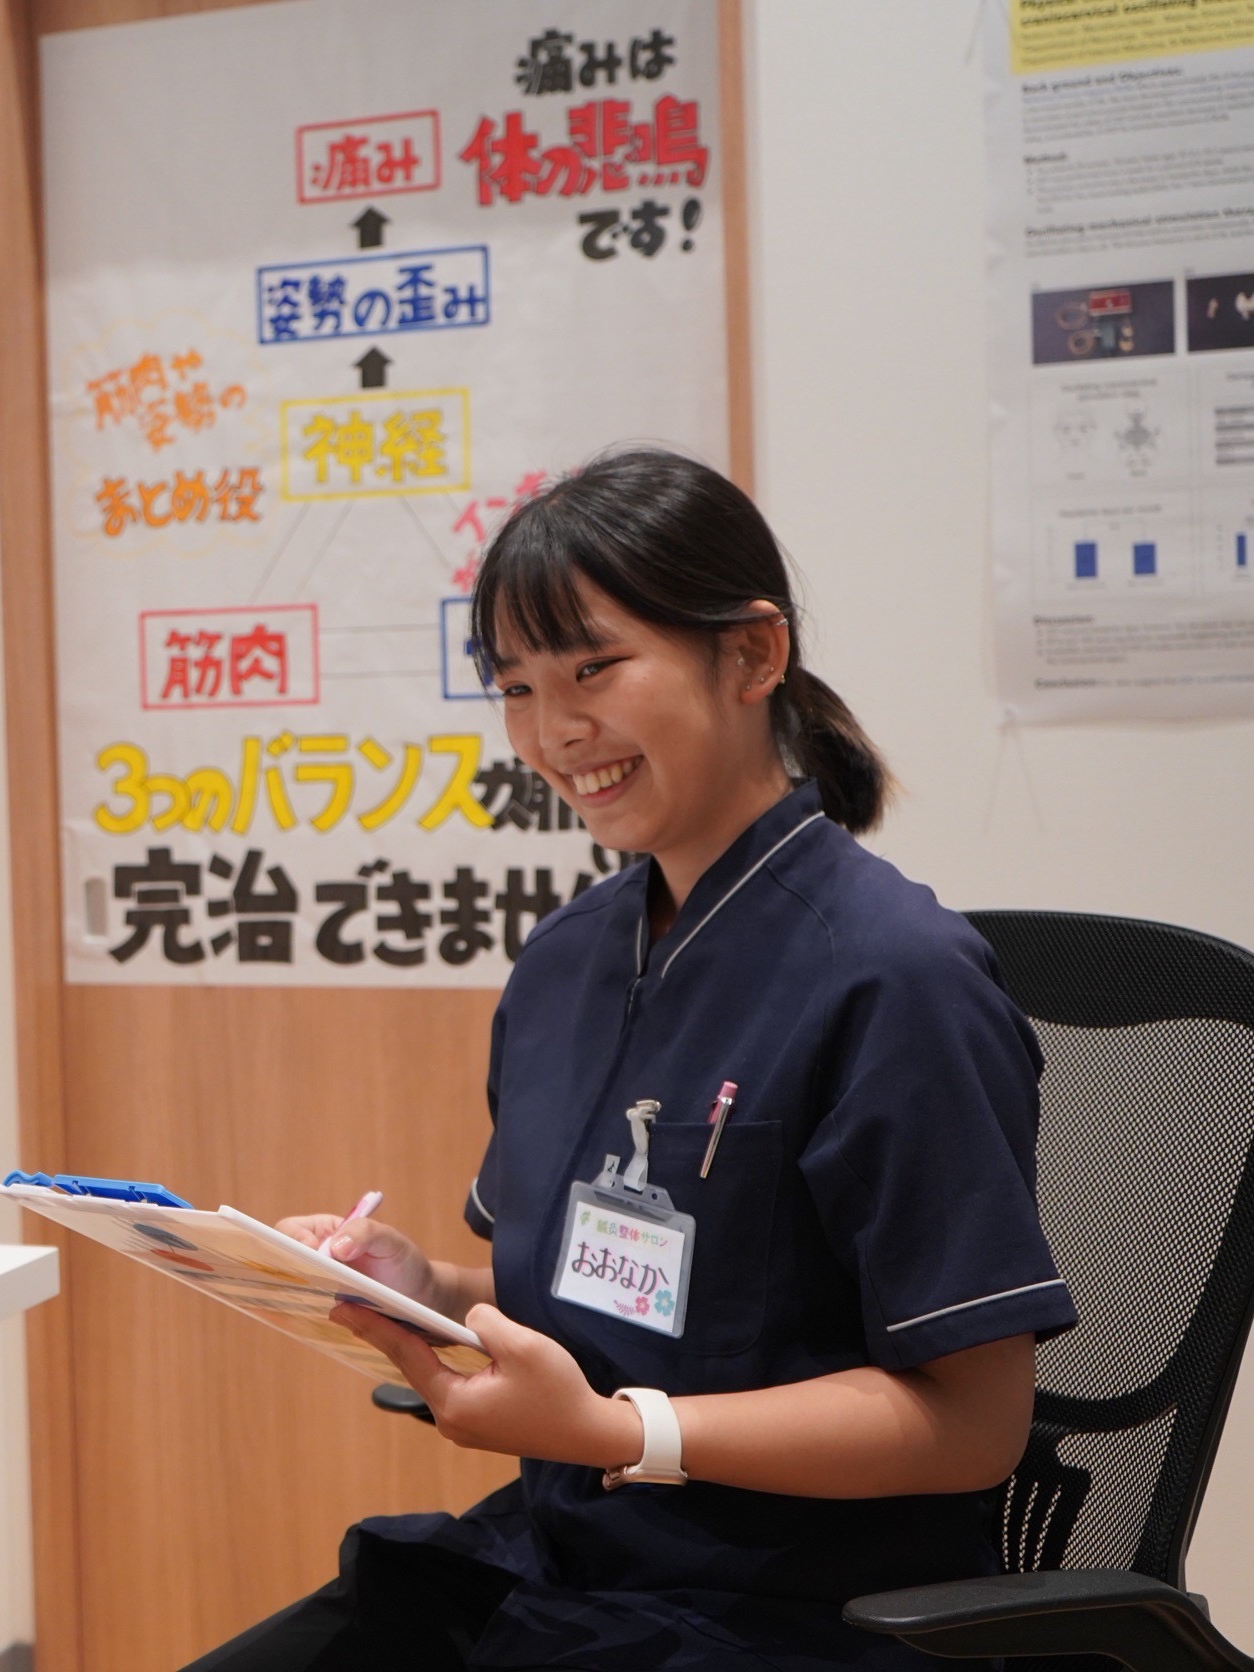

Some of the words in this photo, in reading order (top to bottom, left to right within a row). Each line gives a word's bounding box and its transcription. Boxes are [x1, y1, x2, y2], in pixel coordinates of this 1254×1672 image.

[515, 29, 676, 95] 痛みは
[309, 132, 420, 192] 痛み
[458, 95, 710, 207] 体の悲鳴
[267, 264, 487, 342] 姿勢の歪み
[302, 408, 448, 485] 神経
[96, 466, 265, 538] まとめ役
[161, 624, 289, 700] 筋肉
[571, 1240, 671, 1296] おおなか
